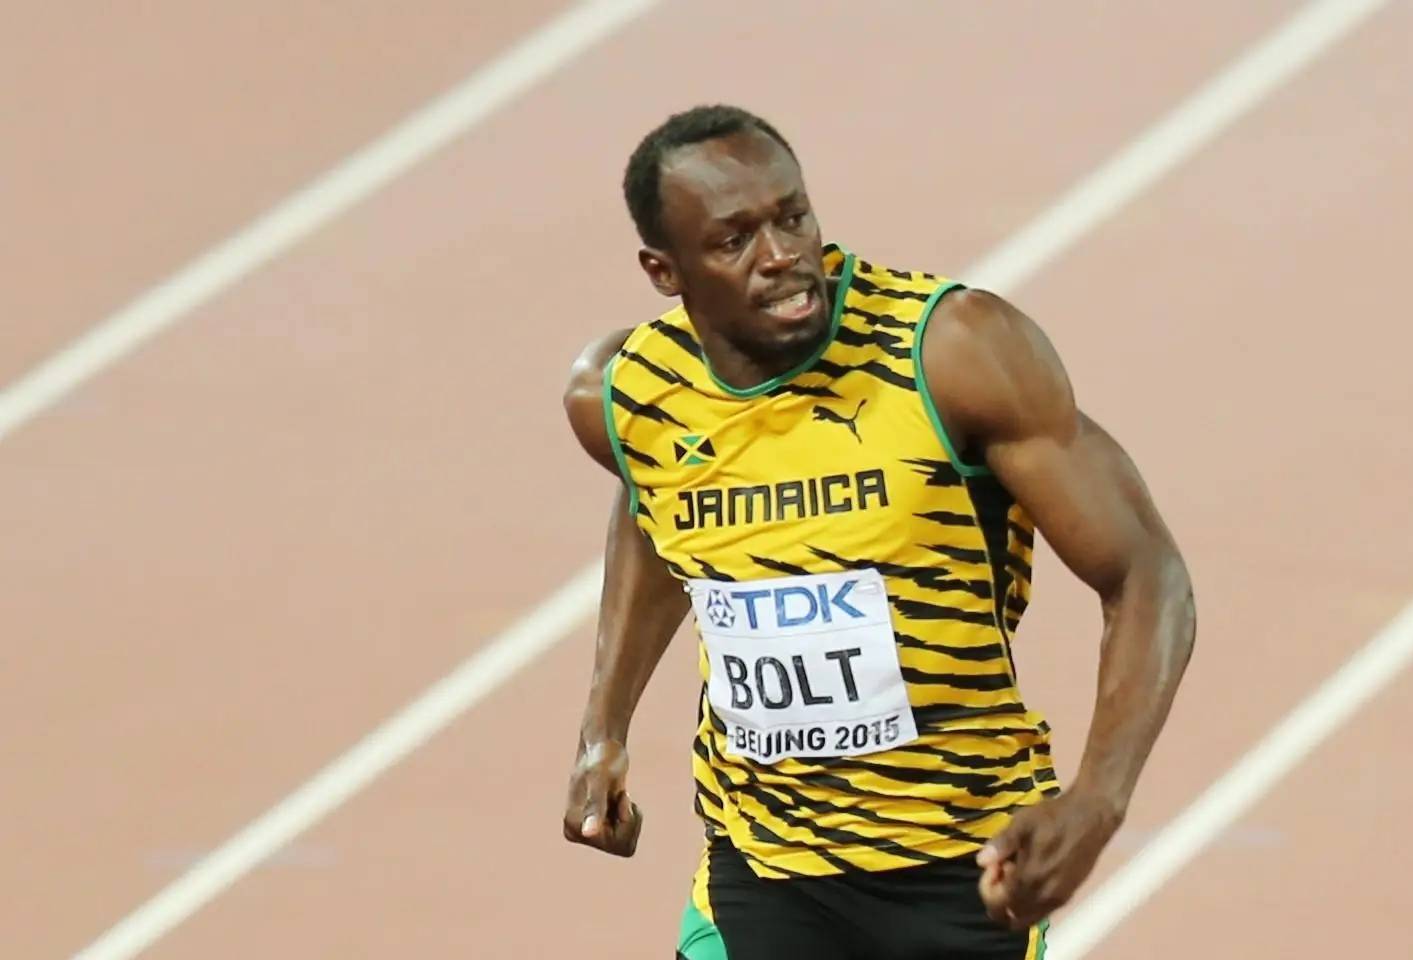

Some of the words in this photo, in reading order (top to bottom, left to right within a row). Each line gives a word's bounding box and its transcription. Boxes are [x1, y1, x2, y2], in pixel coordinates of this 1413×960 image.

[674, 469, 889, 530] JAMAICA
[732, 579, 866, 630] TDK
[723, 647, 862, 710] BOLT
[735, 727, 826, 757] BEIJING
[835, 715, 900, 750] 2015
